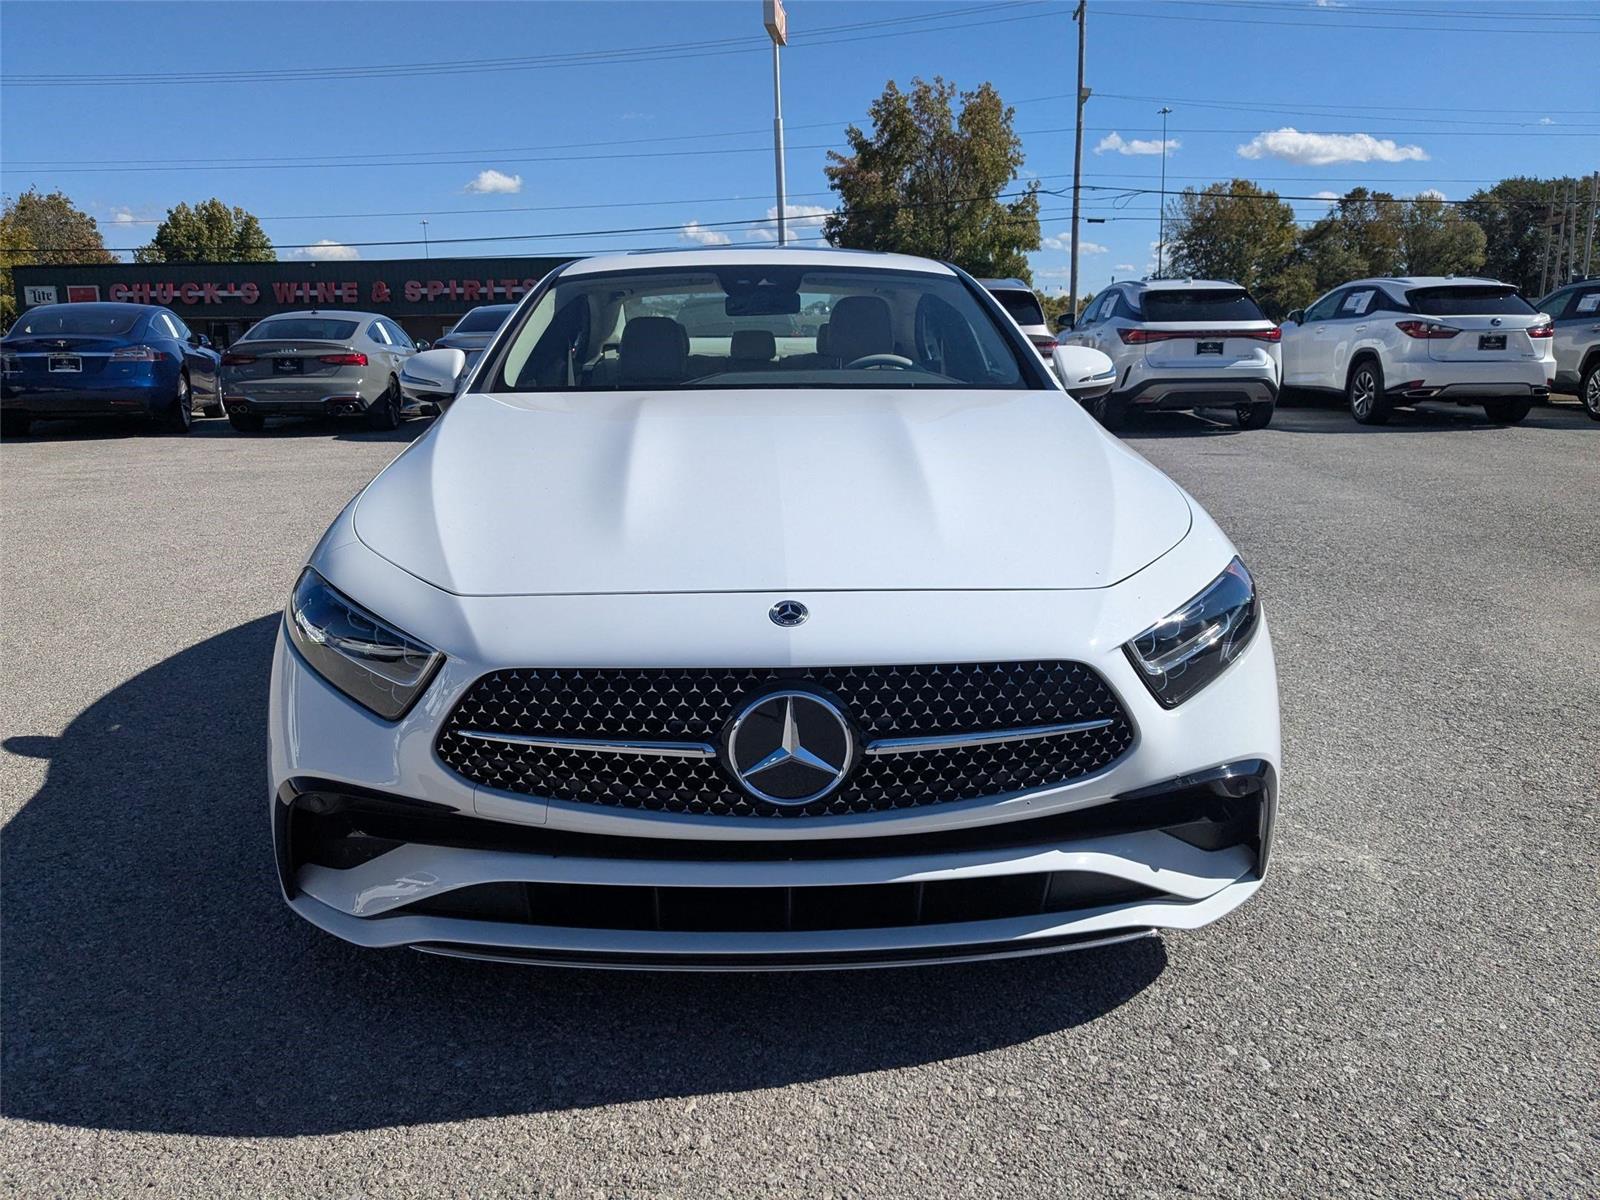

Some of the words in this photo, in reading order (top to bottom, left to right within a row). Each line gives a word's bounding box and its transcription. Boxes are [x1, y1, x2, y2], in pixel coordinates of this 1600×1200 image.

[32, 289, 53, 304] Lite
[109, 282, 259, 305] CHUCK'S
[272, 281, 358, 304] WINE
[371, 280, 391, 303] &
